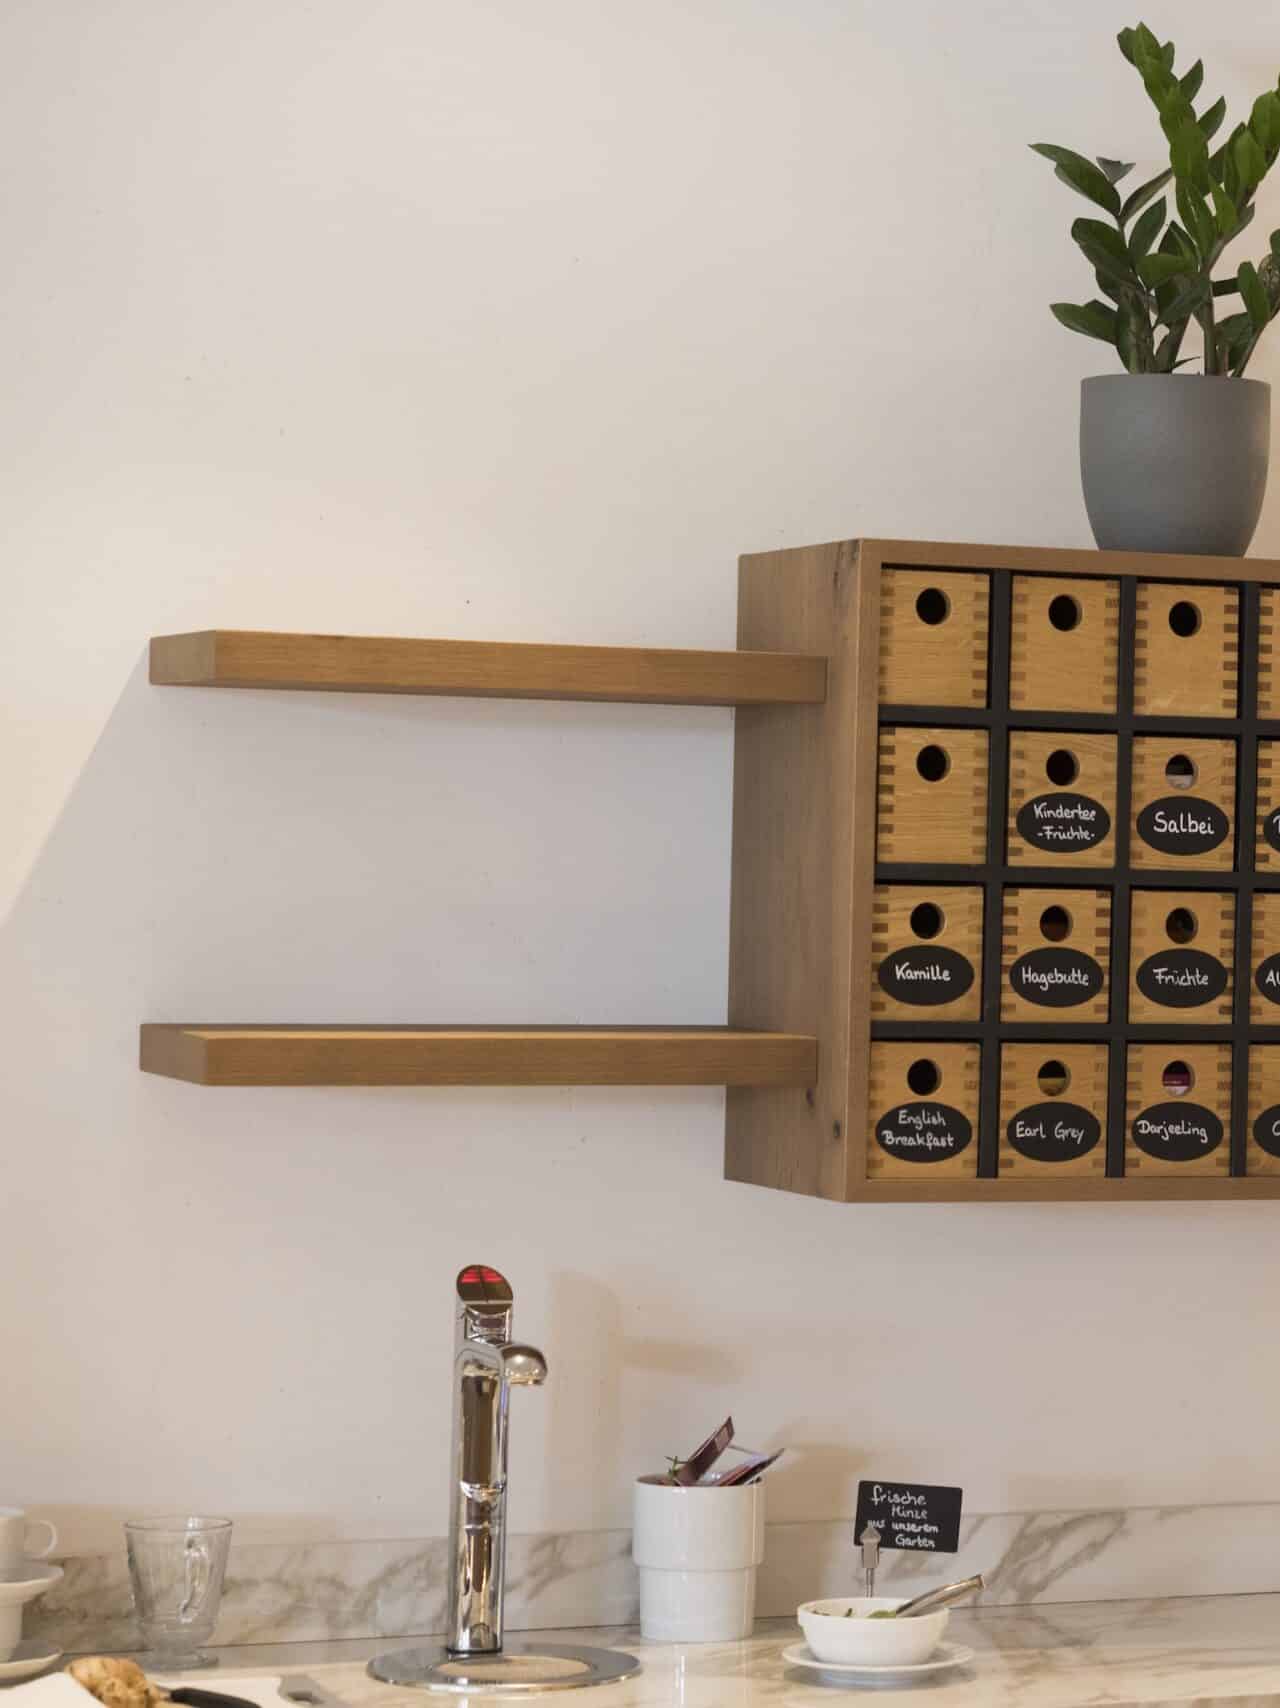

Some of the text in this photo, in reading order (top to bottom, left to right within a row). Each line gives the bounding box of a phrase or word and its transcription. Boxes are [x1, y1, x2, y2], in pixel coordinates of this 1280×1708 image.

[1033, 802, 1096, 821] Kindertee
[1153, 811, 1215, 835] Salbei
[895, 961, 951, 982] Kamille
[1021, 966, 1089, 991] Hagebutte
[1153, 968, 1209, 986] Früchte
[898, 1109, 947, 1130] English
[881, 1130, 955, 1150] Breakfast
[1015, 1121, 1085, 1144] Earl Grey
[1136, 1119, 1208, 1144] Darjeeling
[871, 1485, 927, 1506] frische
[891, 1520, 939, 1534] unserem
[895, 1534, 936, 1548] Garten
